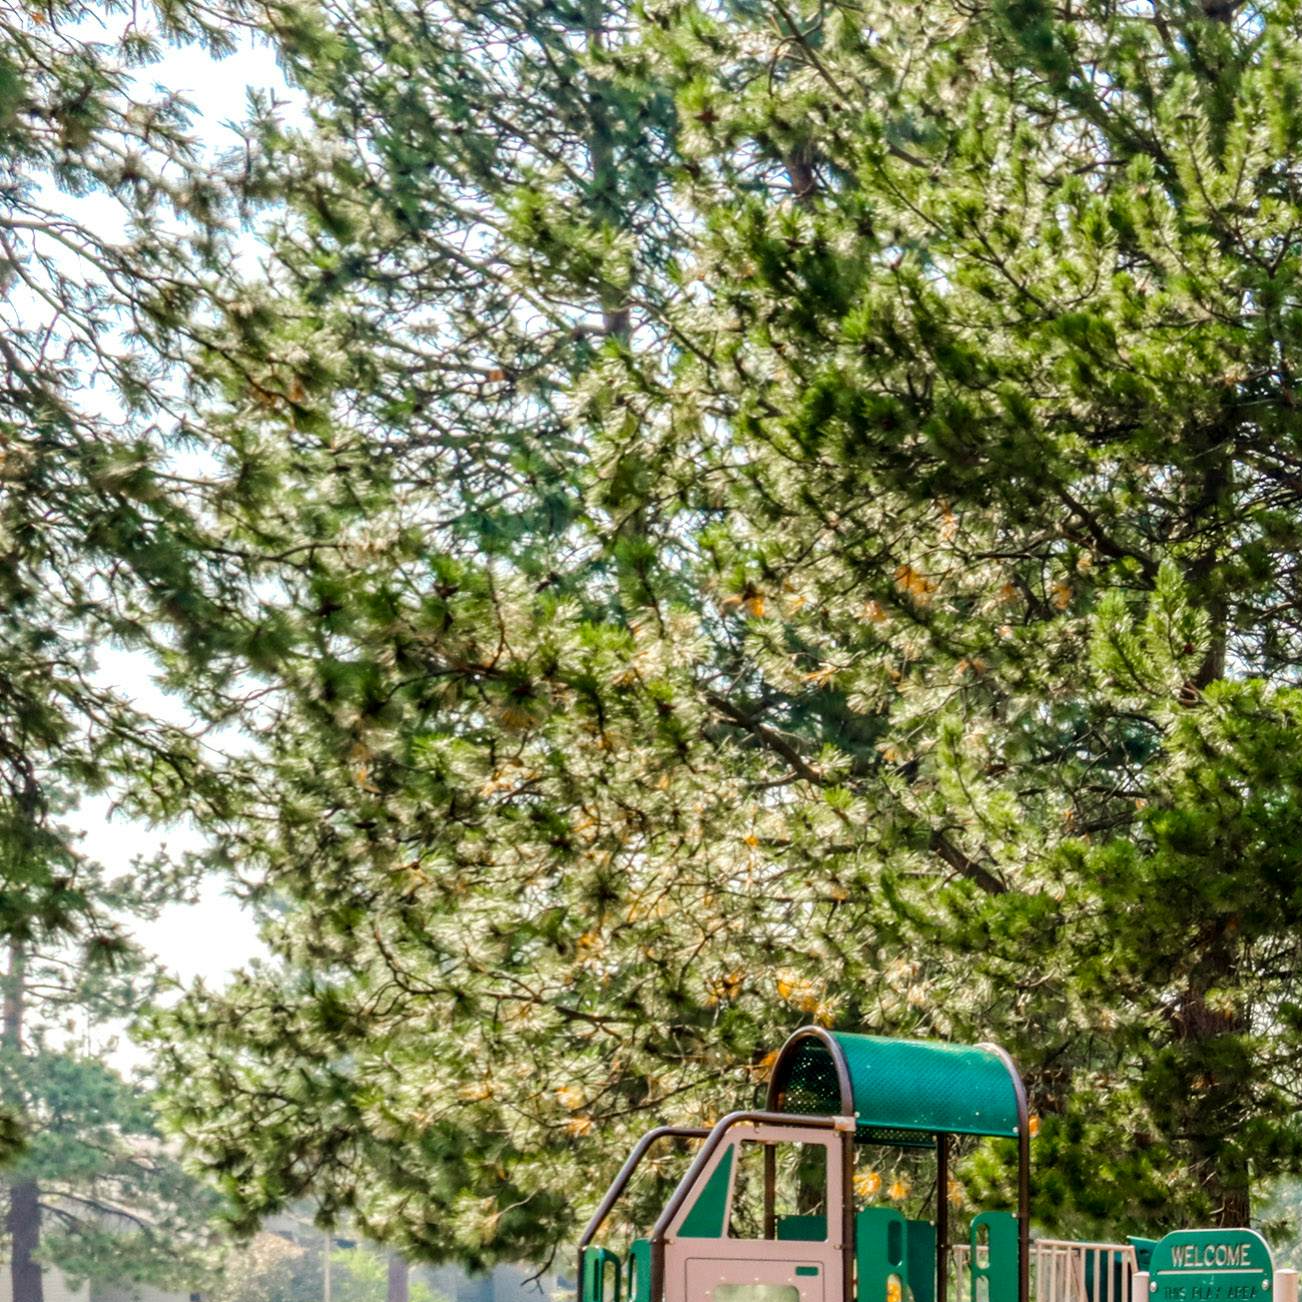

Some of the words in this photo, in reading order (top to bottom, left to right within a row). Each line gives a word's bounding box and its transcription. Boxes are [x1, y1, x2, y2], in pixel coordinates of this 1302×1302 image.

[1171, 1244, 1251, 1268] WELCOME
[1164, 1286, 1187, 1302] THIS
[1192, 1286, 1222, 1301] PLAY
[1228, 1286, 1258, 1301] AREA
